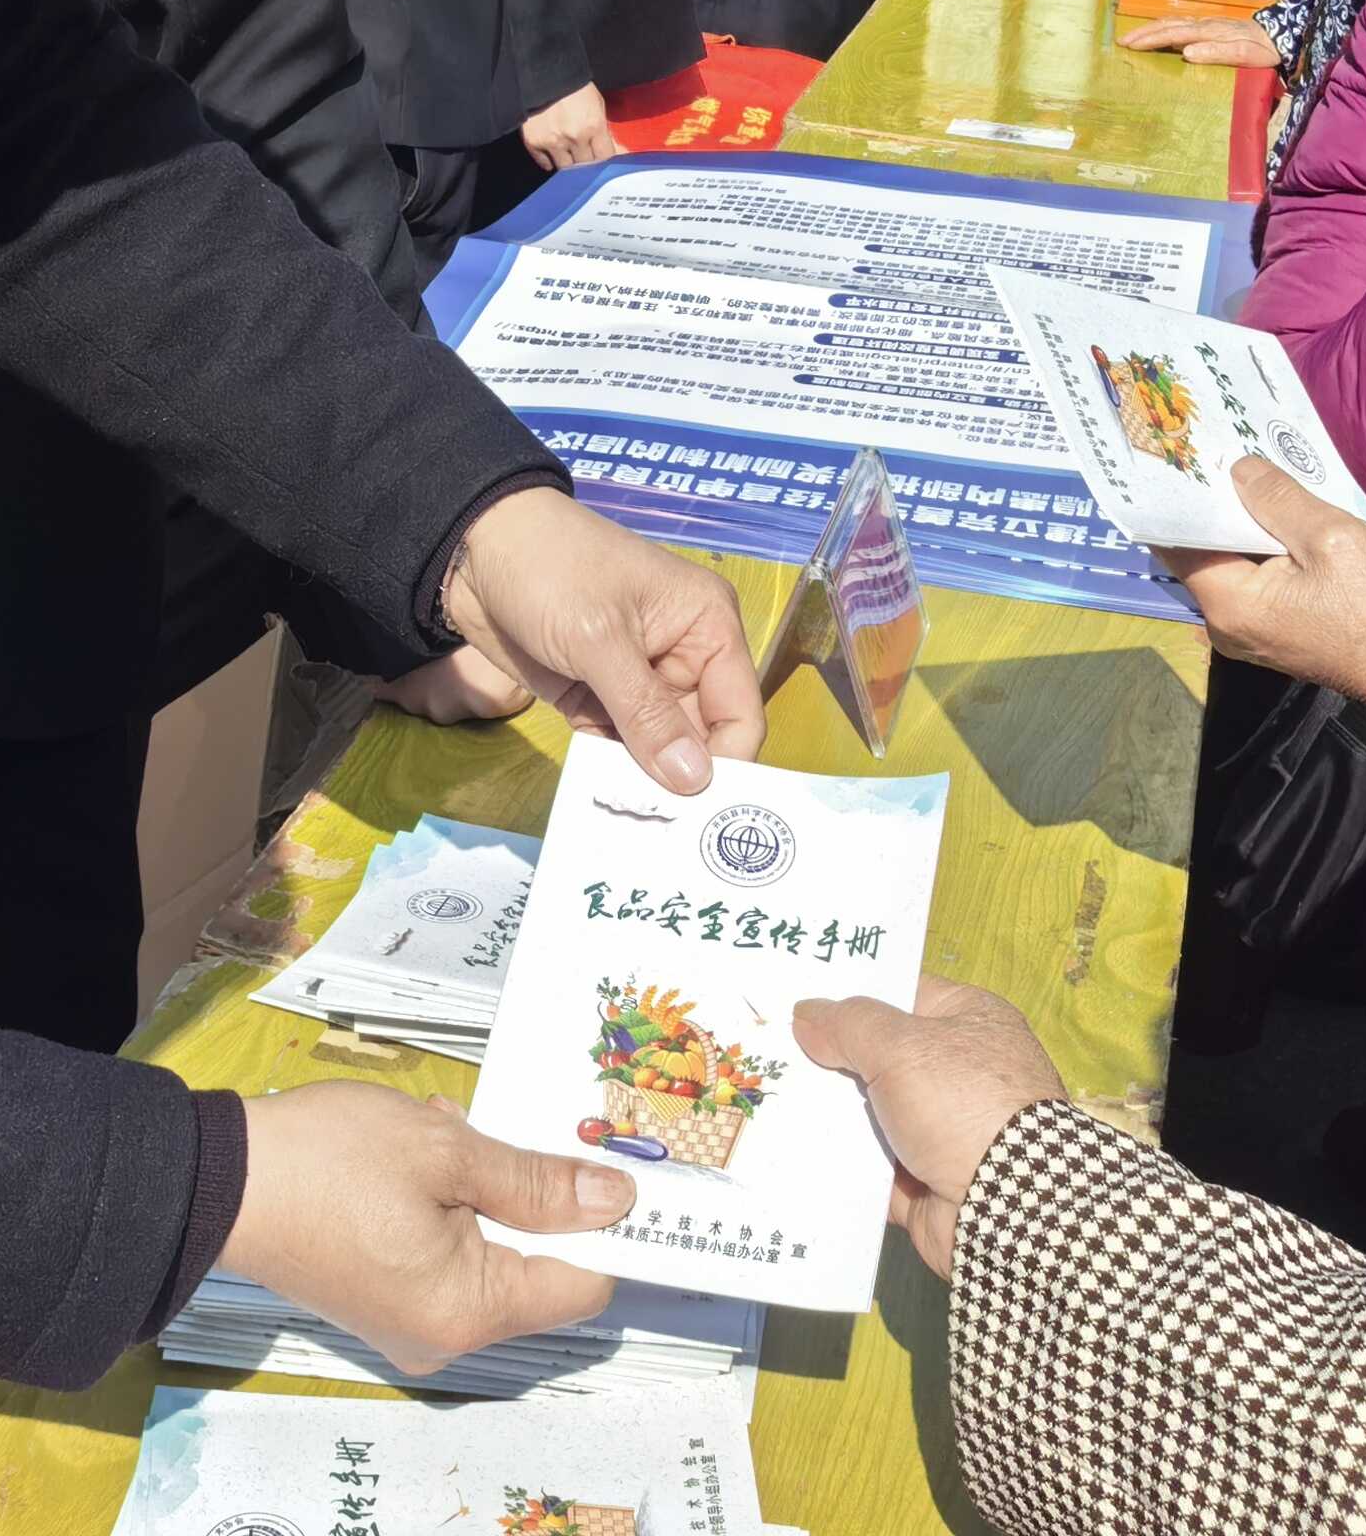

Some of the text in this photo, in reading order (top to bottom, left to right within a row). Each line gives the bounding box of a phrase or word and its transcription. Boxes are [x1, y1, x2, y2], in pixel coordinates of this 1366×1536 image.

[531, 429, 1106, 517] 隐患内部报奖励机制的倡议
[553, 457, 1151, 554] 于建立完善经营单位食品
[583, 880, 887, 963] 食品安全宣传手册
[625, 1209, 784, 1246] 学技术协会
[791, 1242, 808, 1260] 宣
